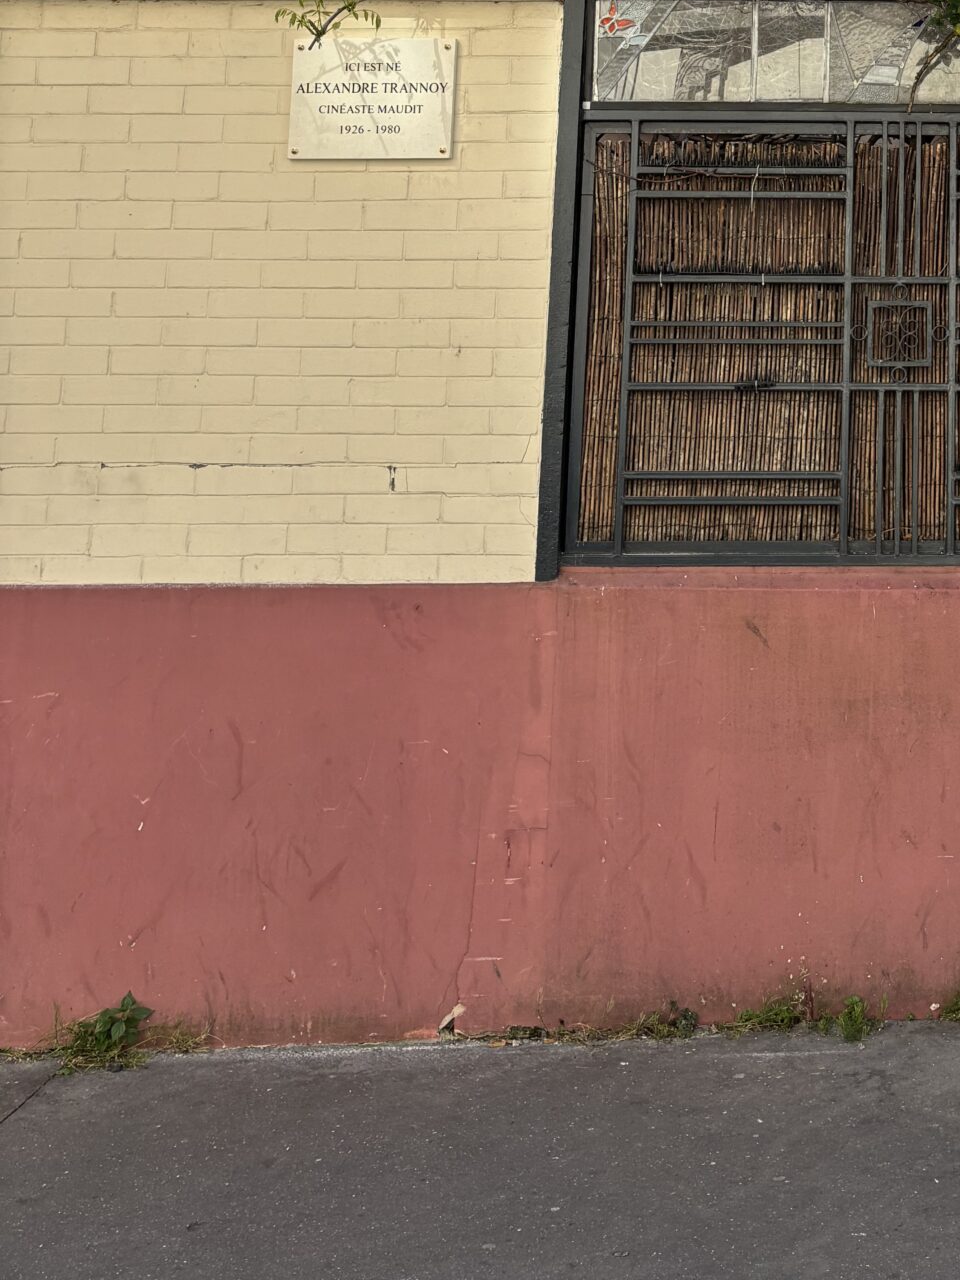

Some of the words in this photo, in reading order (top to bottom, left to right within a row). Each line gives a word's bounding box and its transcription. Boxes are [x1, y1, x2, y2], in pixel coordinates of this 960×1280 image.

[345, 62, 360, 72] ICI
[363, 62, 384, 72] EST
[386, 60, 402, 72] NÉ
[296, 83, 378, 94] ALEXANDRE
[382, 82, 449, 94] TRANNOY
[318, 103, 374, 114] CINÉASTE
[377, 104, 424, 114] MAUDIT
[339, 125, 365, 134] 1926
[375, 125, 401, 134] 1980
